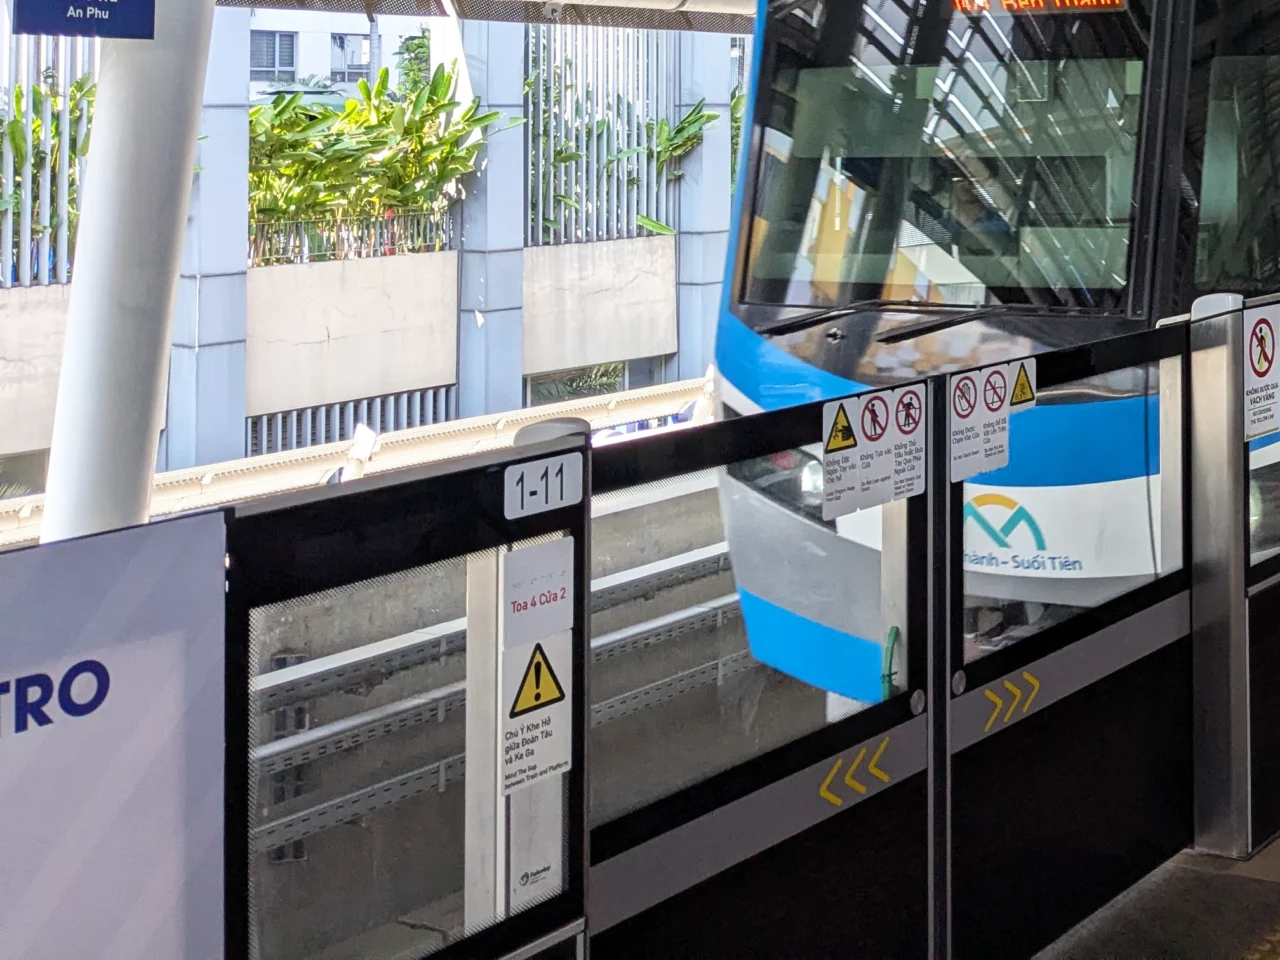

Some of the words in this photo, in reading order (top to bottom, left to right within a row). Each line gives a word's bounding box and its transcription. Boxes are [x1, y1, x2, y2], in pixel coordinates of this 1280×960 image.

[66, 5, 84, 18] An
[86, 6, 109, 19] Phu
[515, 462, 564, 511] 1-11
[1011, 553, 1047, 571] Suối
[1048, 555, 1083, 571] Tiên
[511, 600, 528, 614] Toa
[530, 596, 537, 608] 4
[539, 589, 558, 606] Cửa
[560, 587, 567, 600] 2
[504, 728, 519, 741] Chú
[520, 724, 526, 736] Ý
[526, 722, 540, 734] Khe
[541, 715, 552, 728] Hở
[504, 742, 520, 756] giữa
[521, 734, 539, 748] Đoàn
[540, 729, 553, 740] Tàu
[504, 755, 513, 766] và
[514, 751, 524, 762] Ke
[525, 748, 535, 758] Ga
[504, 771, 518, 781] Mind
[518, 767, 527, 776] The
[527, 763, 538, 772] Gap
[504, 777, 526, 790] between
[526, 772, 539, 782] Train
[539, 767, 549, 777] and
[548, 760, 569, 773] Platform
